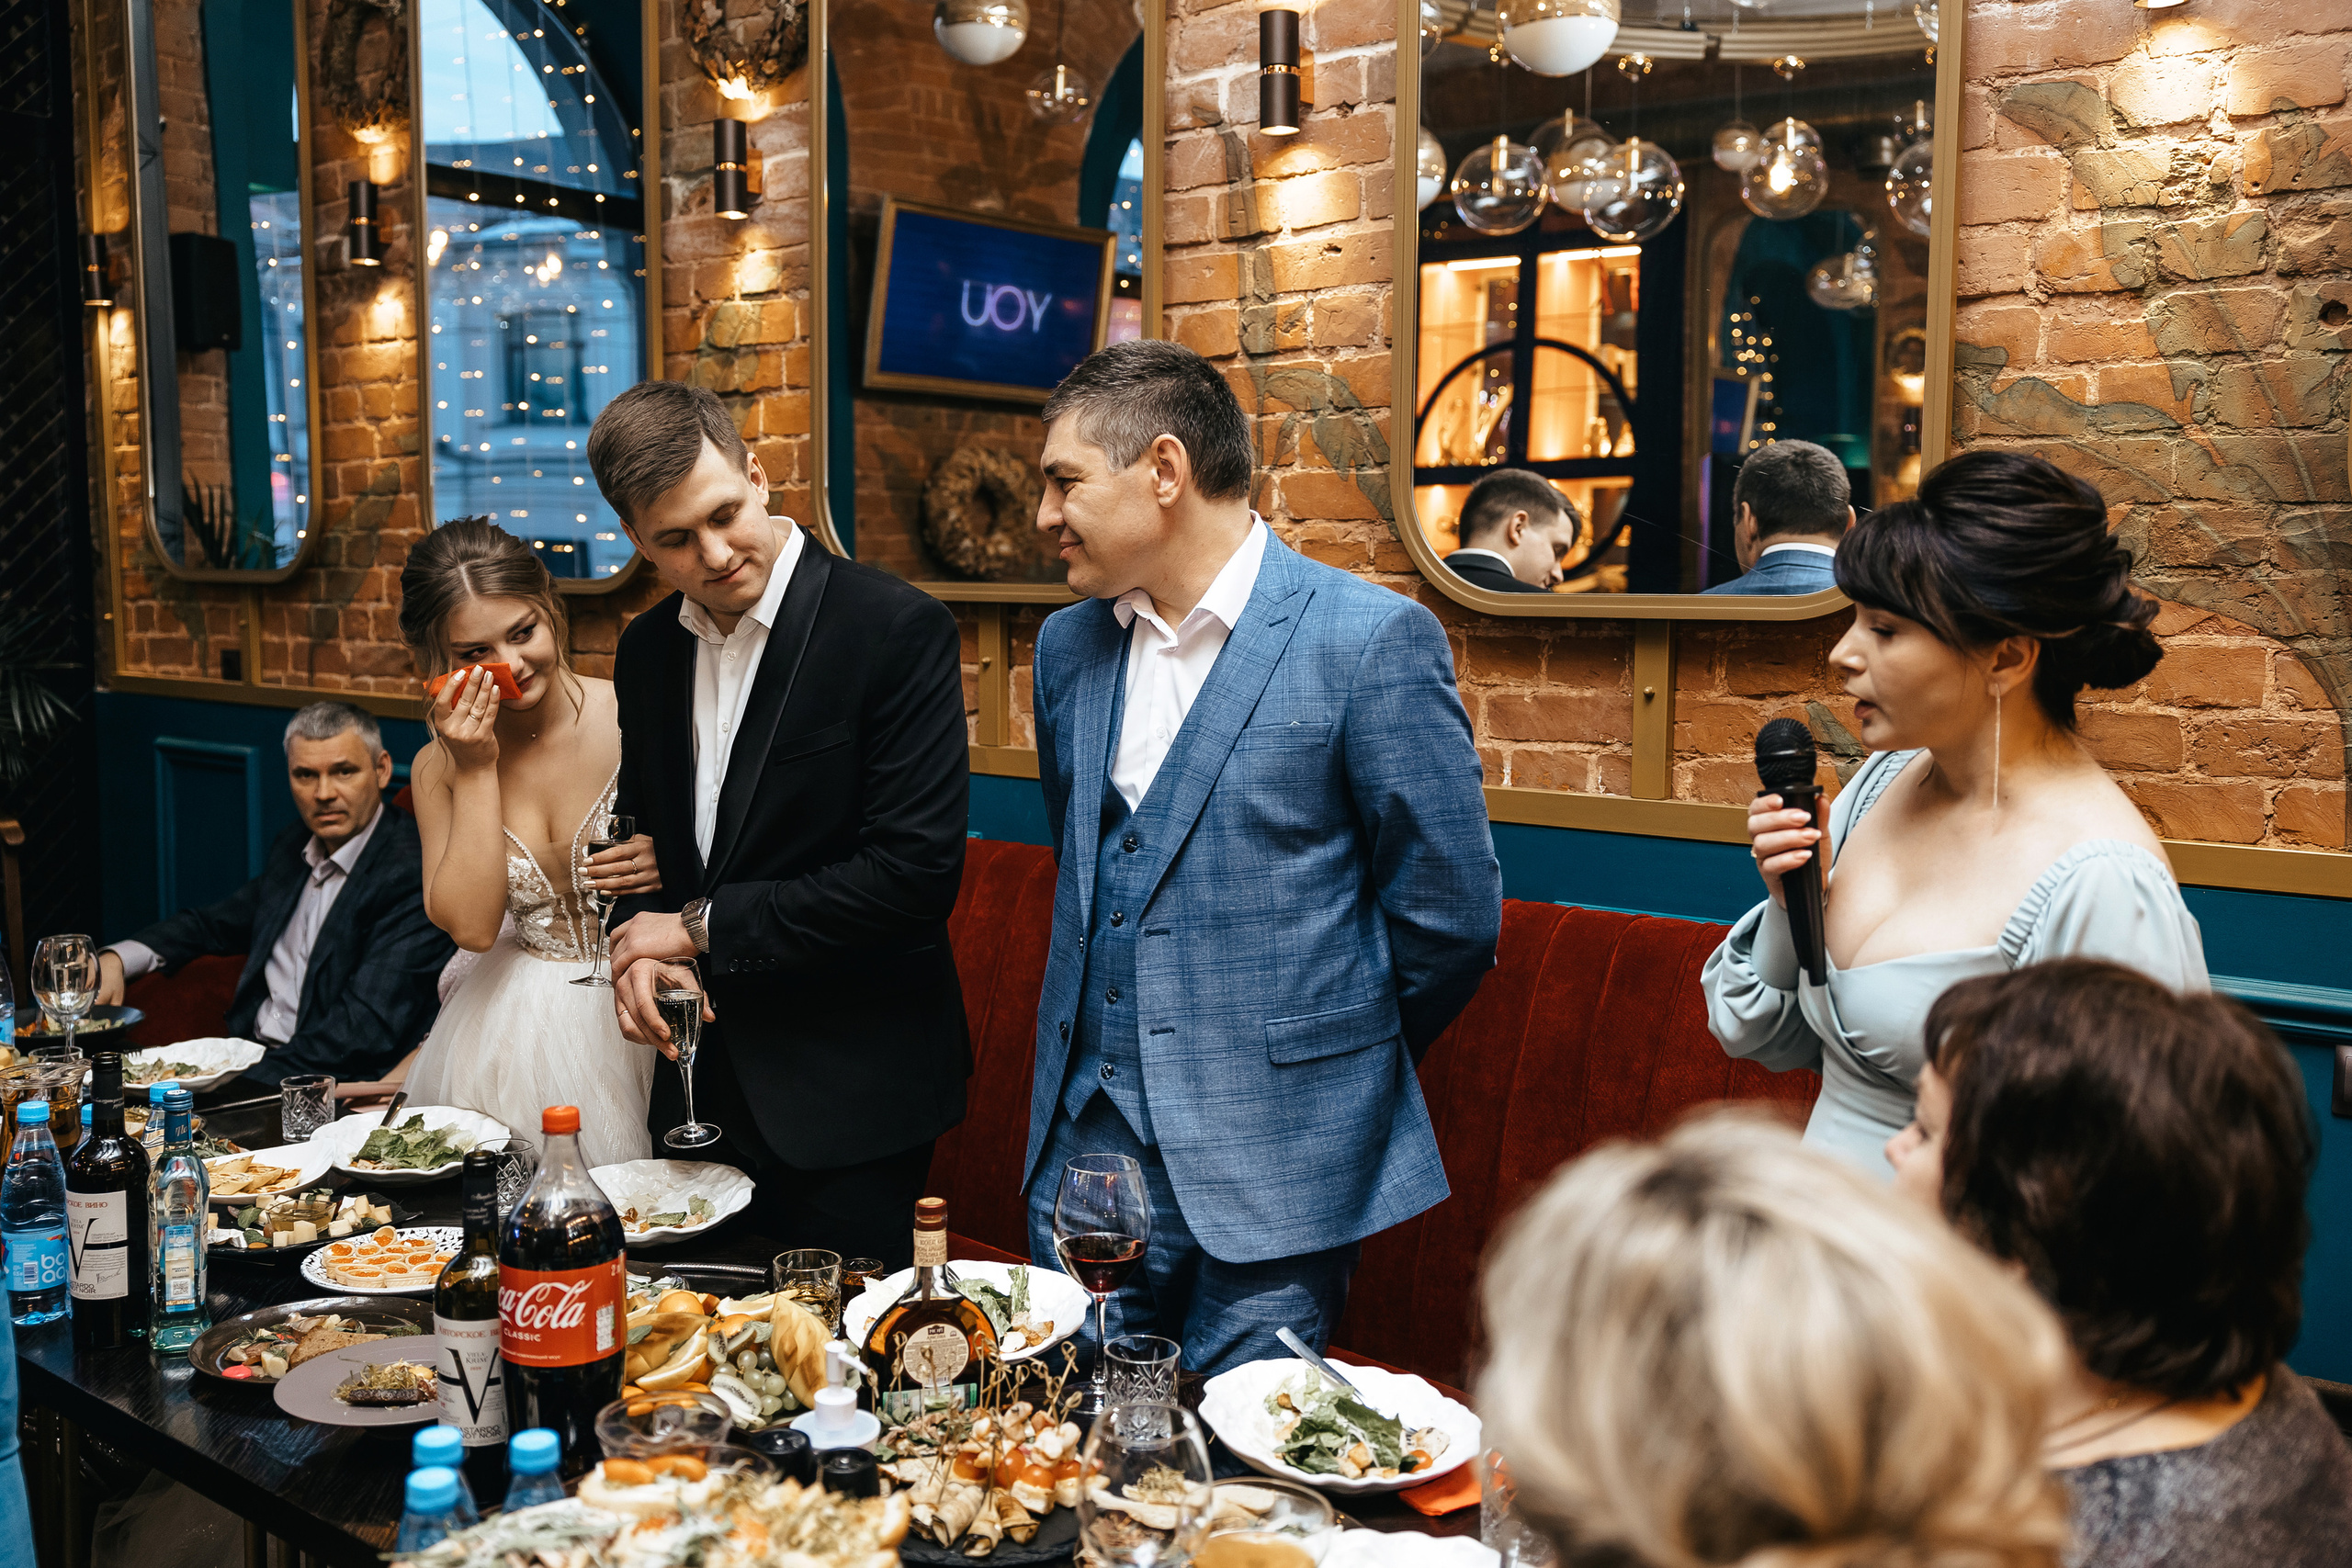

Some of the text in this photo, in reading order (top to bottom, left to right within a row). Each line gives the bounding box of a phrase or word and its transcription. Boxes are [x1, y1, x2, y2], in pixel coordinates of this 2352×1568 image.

[498, 1278, 595, 1330] ca-Cola
[503, 1327, 541, 1343] CLASSIC
[465, 1357, 486, 1365] KRIM
[479, 1430, 502, 1439] NOIR
